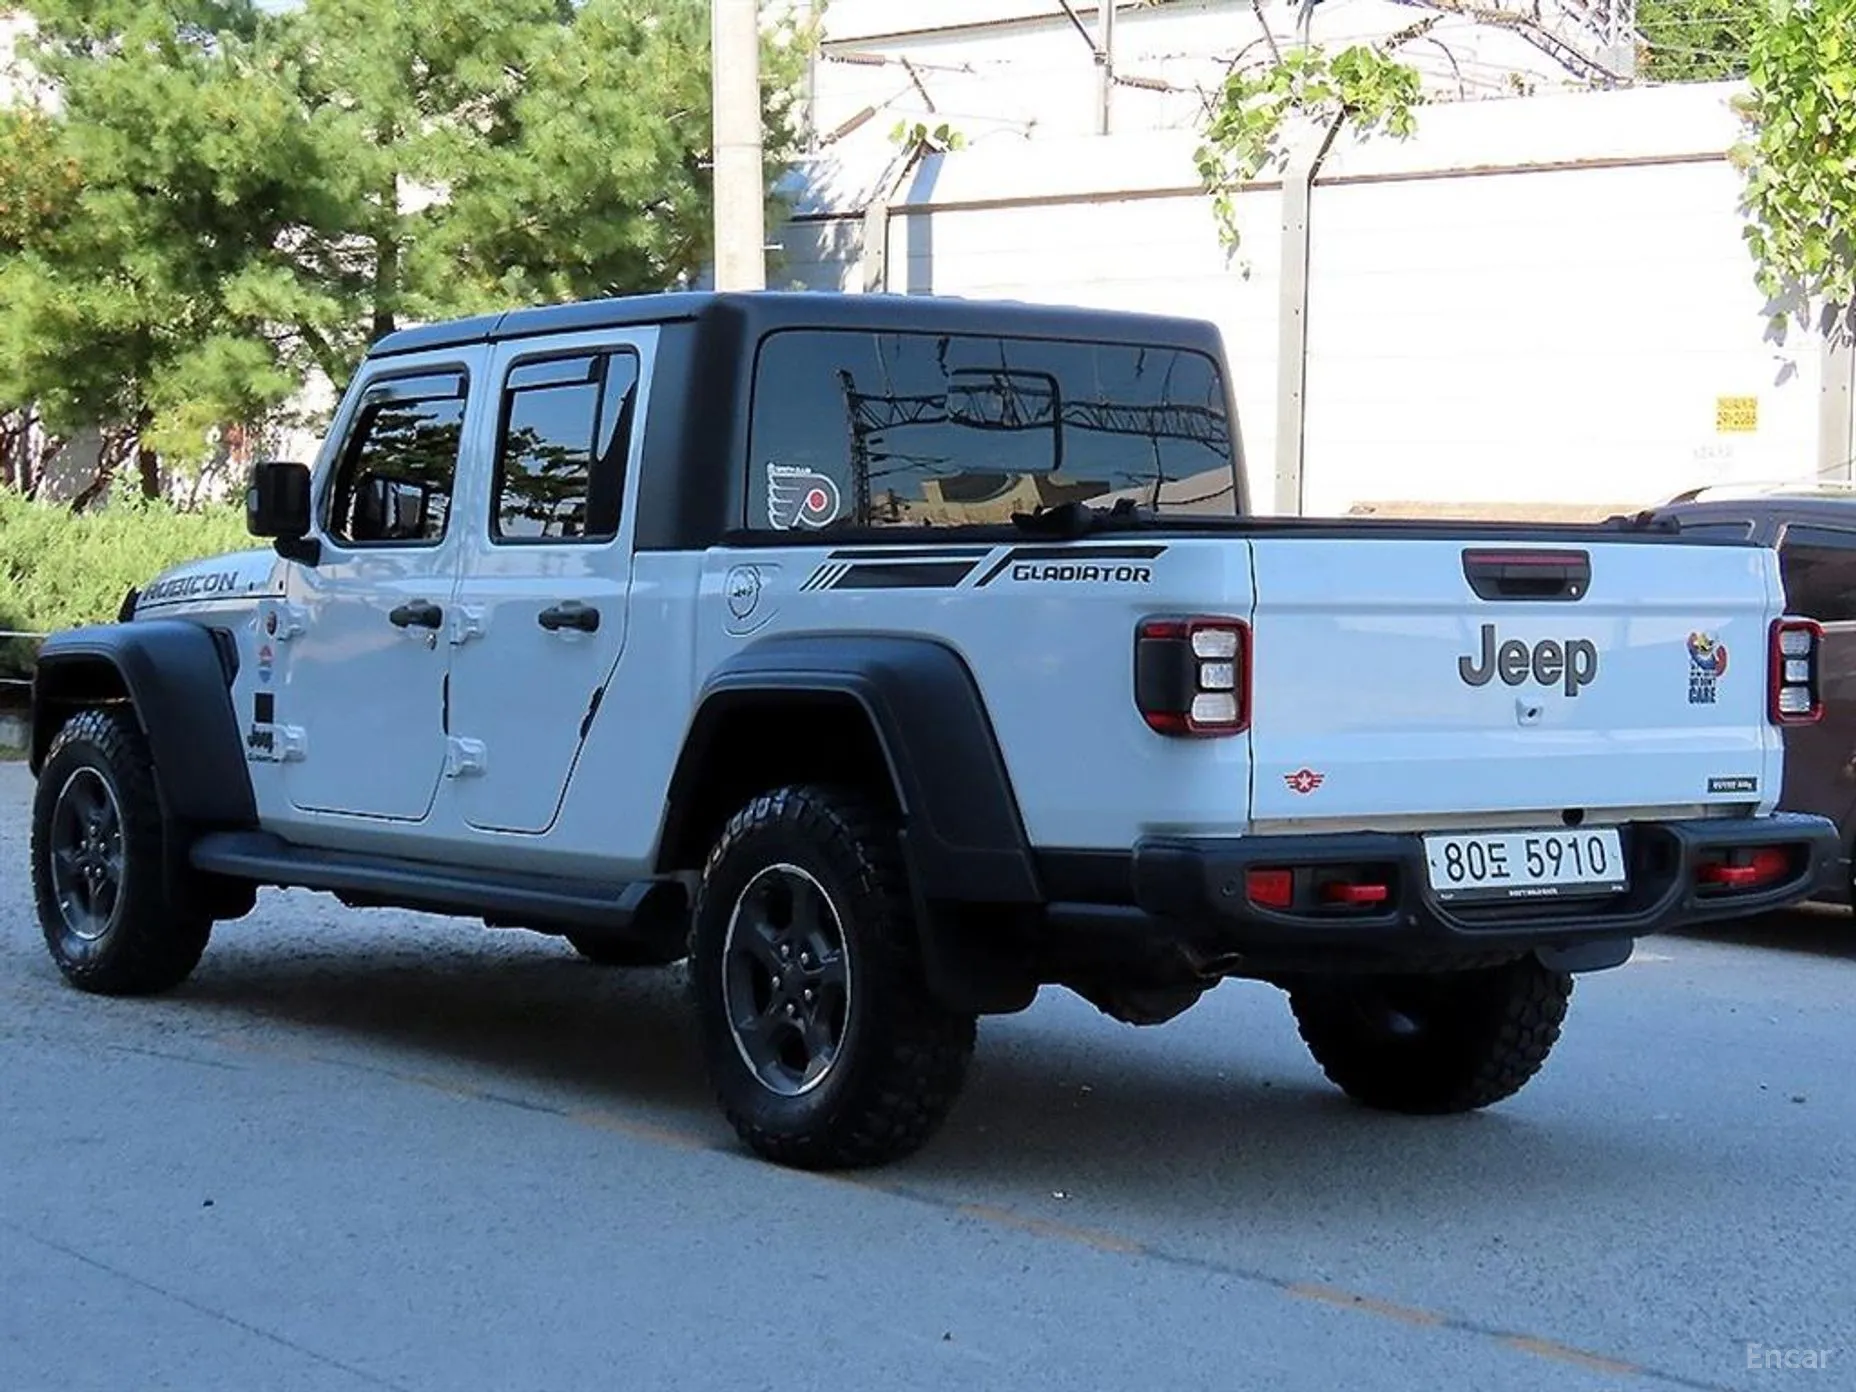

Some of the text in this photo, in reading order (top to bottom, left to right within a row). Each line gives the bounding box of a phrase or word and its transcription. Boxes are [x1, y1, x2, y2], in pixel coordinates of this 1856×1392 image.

[144, 571, 239, 601] RUBICON
[1013, 565, 1151, 582] GLADIATOR
[1458, 623, 1598, 697] Jeep
[1444, 836, 1607, 882] 80도 5910
